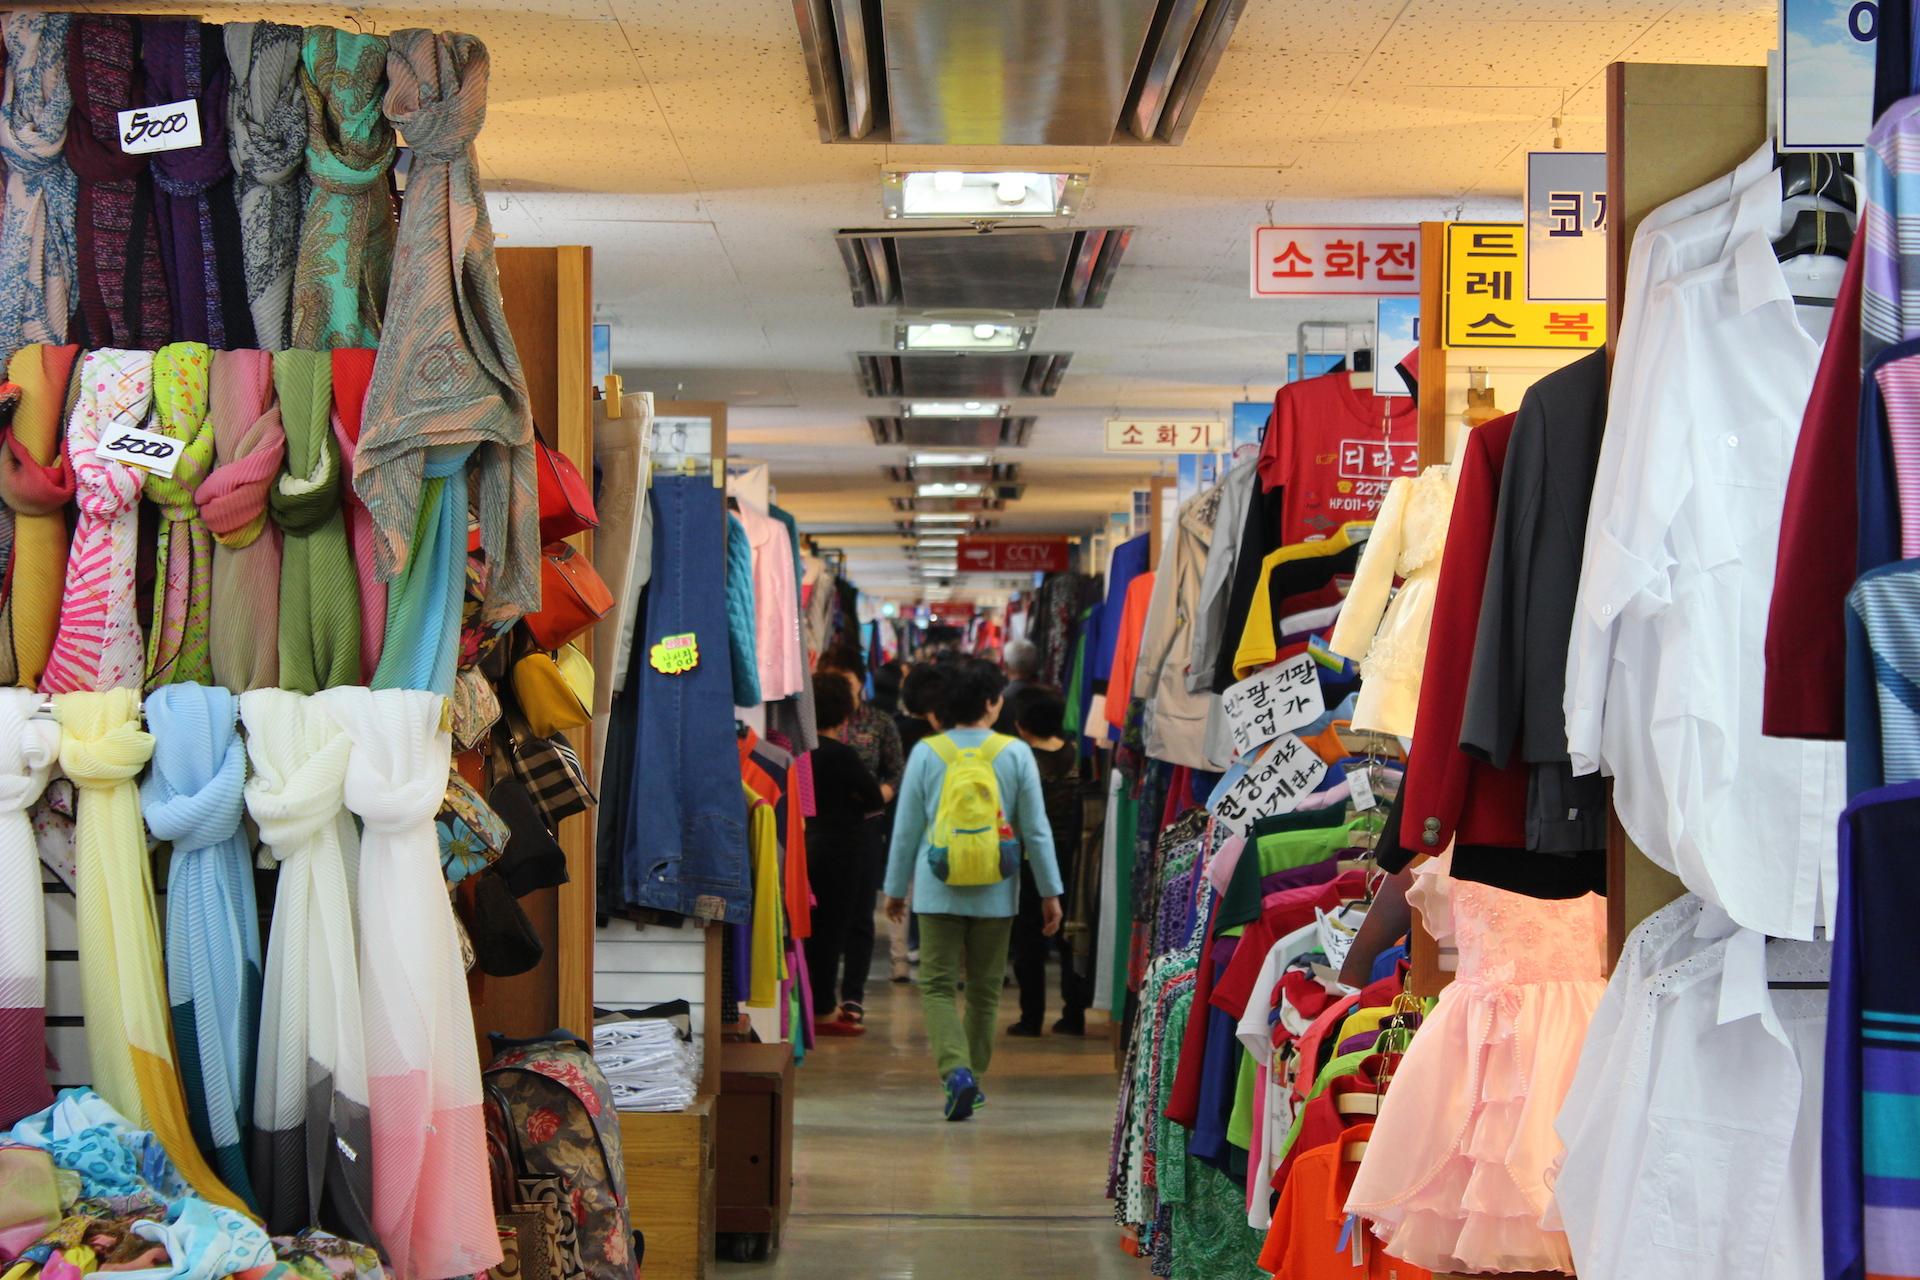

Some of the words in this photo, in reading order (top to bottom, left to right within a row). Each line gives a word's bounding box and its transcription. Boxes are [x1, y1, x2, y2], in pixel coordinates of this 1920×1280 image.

[1272, 239, 1415, 281] 소화전
[1466, 234, 1518, 338] 드레스
[106, 434, 174, 458] 5000
[1121, 424, 1210, 447] 소화기
[1006, 545, 1050, 560] CCTV
